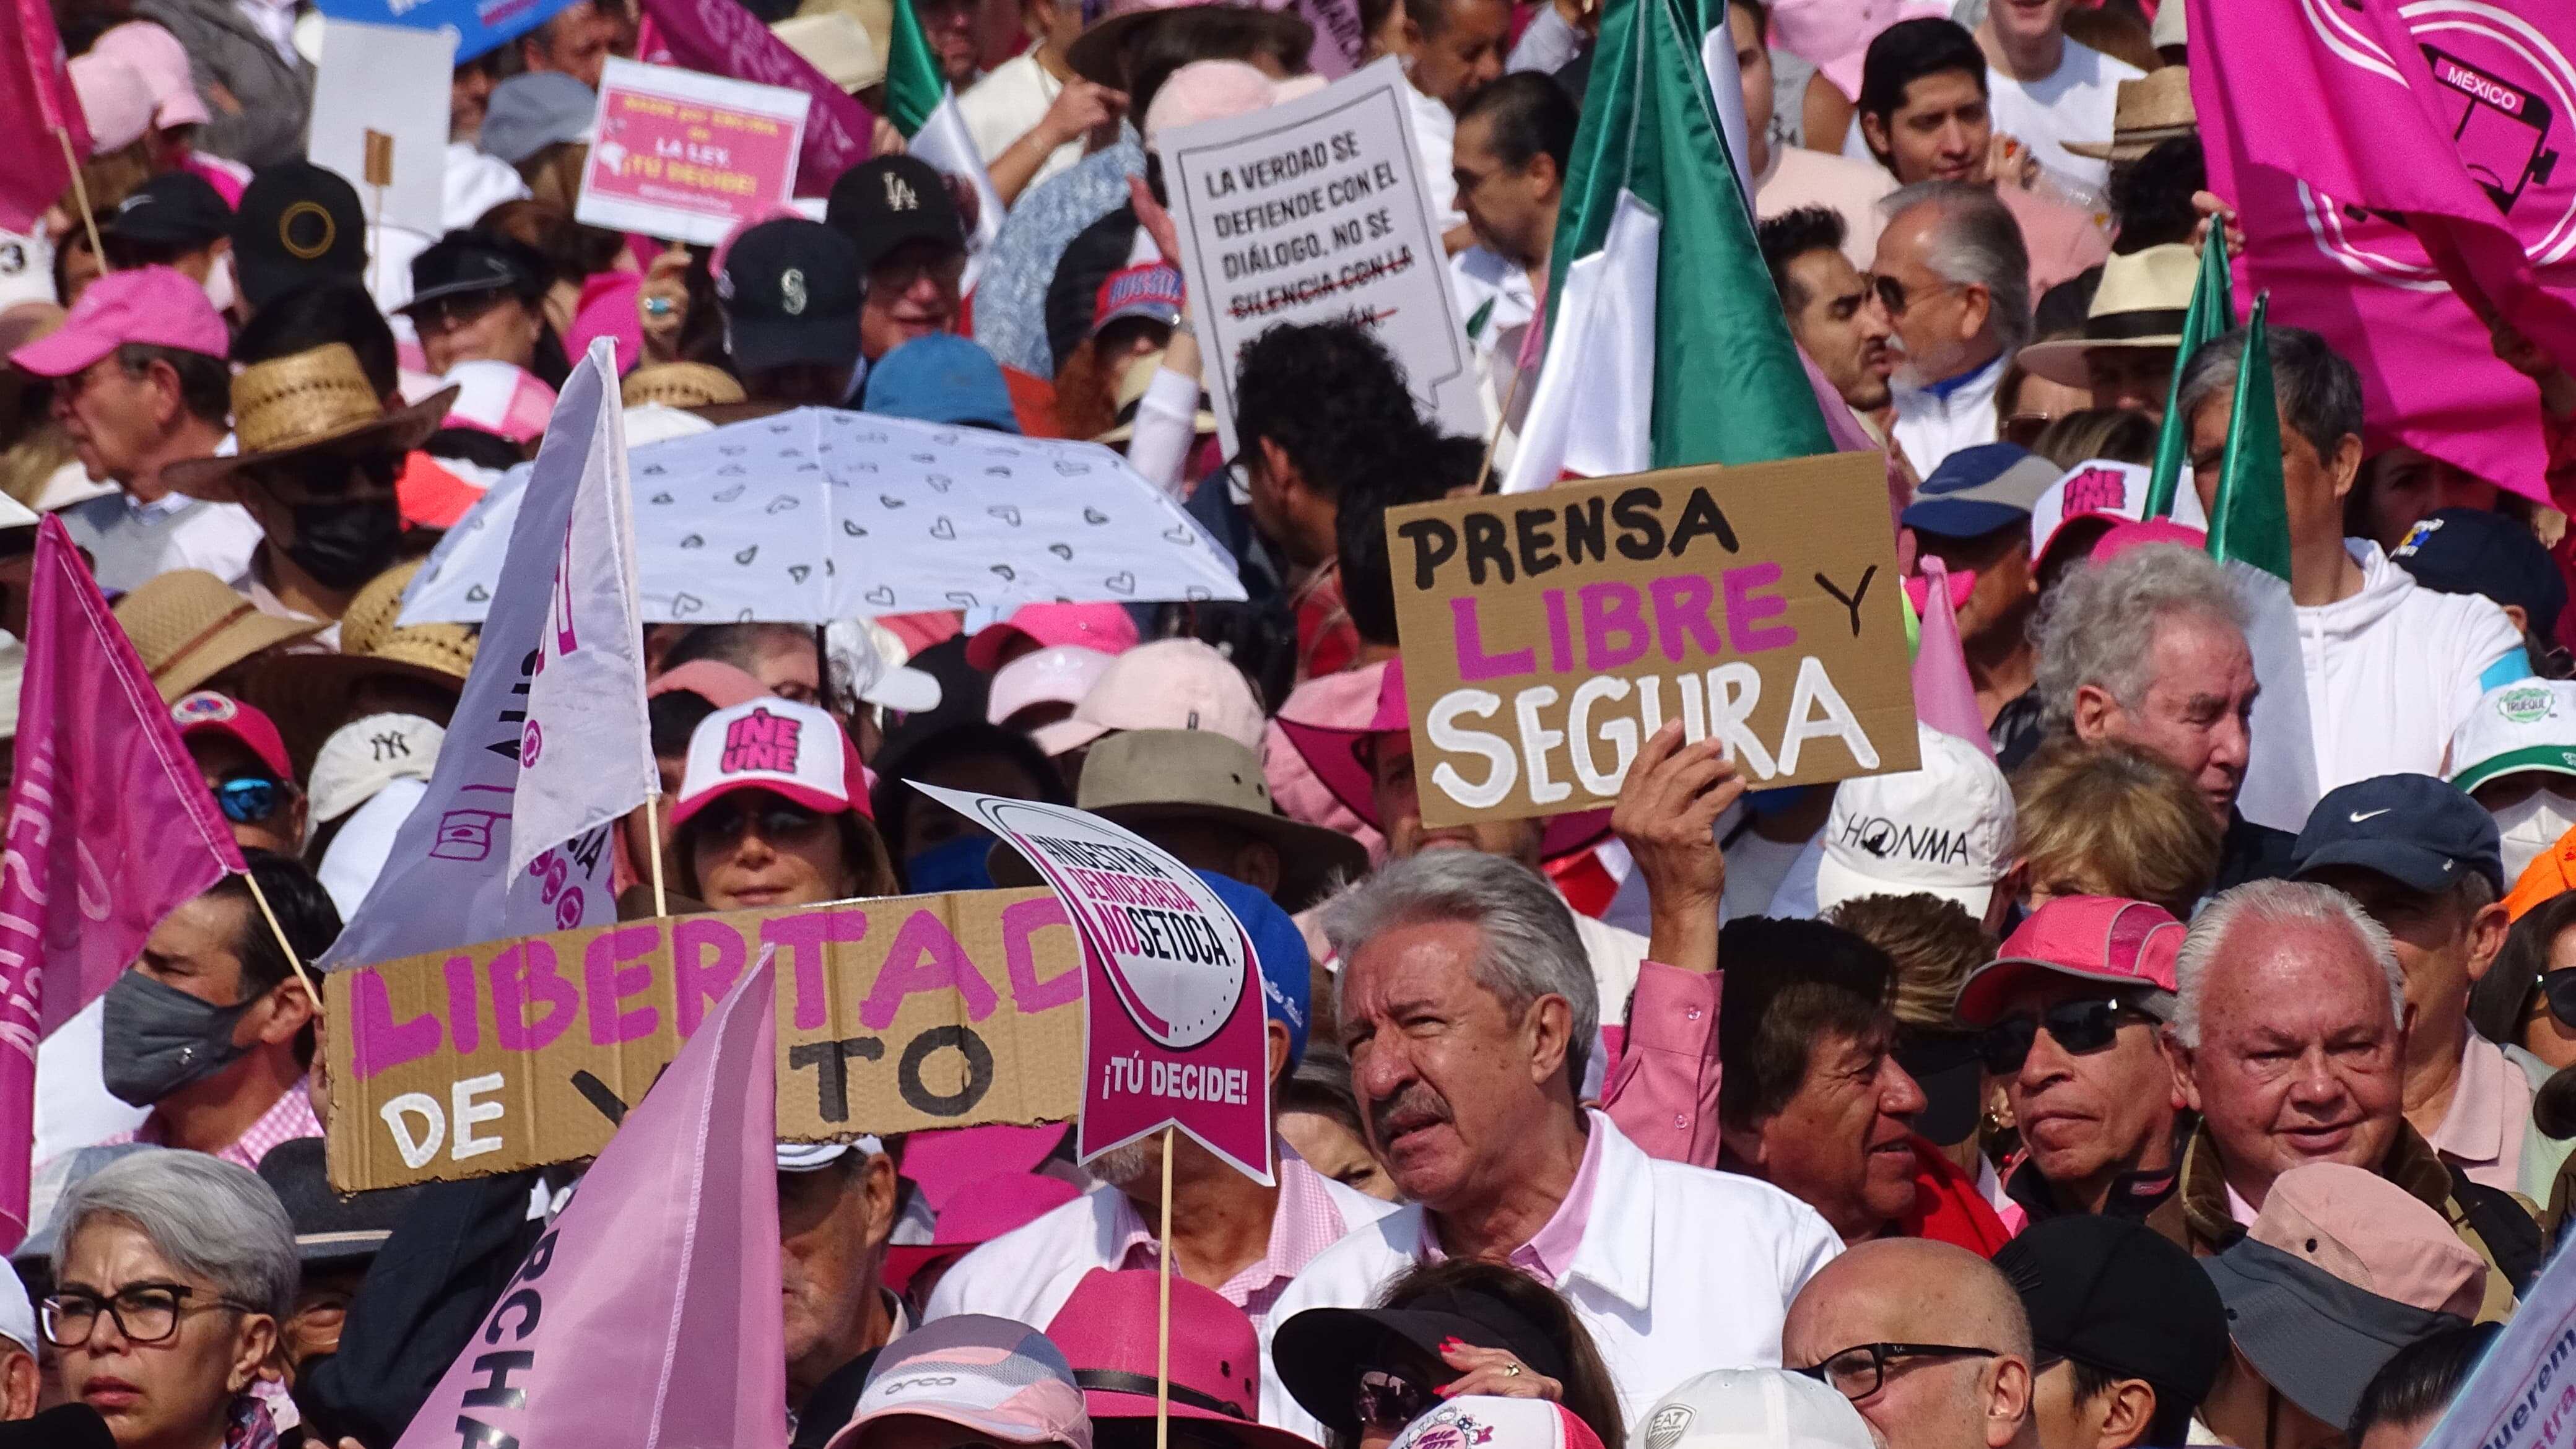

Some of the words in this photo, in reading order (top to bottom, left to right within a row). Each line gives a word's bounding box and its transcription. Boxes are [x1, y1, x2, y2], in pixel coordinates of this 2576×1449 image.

[2448, 66, 2516, 110] MÉXICO
[655, 137, 682, 157] LA
[1206, 168, 1237, 199] LA
[1240, 141, 1329, 191] VERDAD
[1331, 130, 1360, 162] SE
[1214, 187, 1325, 238] DEFIENDE
[1328, 168, 1372, 207] CON
[1373, 160, 1398, 191] EL
[1332, 219, 1363, 250] NO
[1366, 207, 1394, 240] SE
[1398, 486, 1739, 590] PRENSA
[1450, 562, 1798, 682] LIBRE
[1814, 565, 1878, 638] Y
[726, 707, 803, 751] INE
[1426, 656, 1881, 808] SEGURA
[720, 743, 798, 774] UNE
[1025, 833, 1173, 880] #NUESTRA
[1840, 812, 1969, 866] HONMA
[1064, 866, 1204, 913] DEMOCRACIA
[350, 896, 1084, 1081] LIBERTAD
[1102, 1050, 1144, 1100] ¡TÚ
[1151, 1060, 1248, 1105] DECIDE!
[380, 1072, 505, 1169] DE
